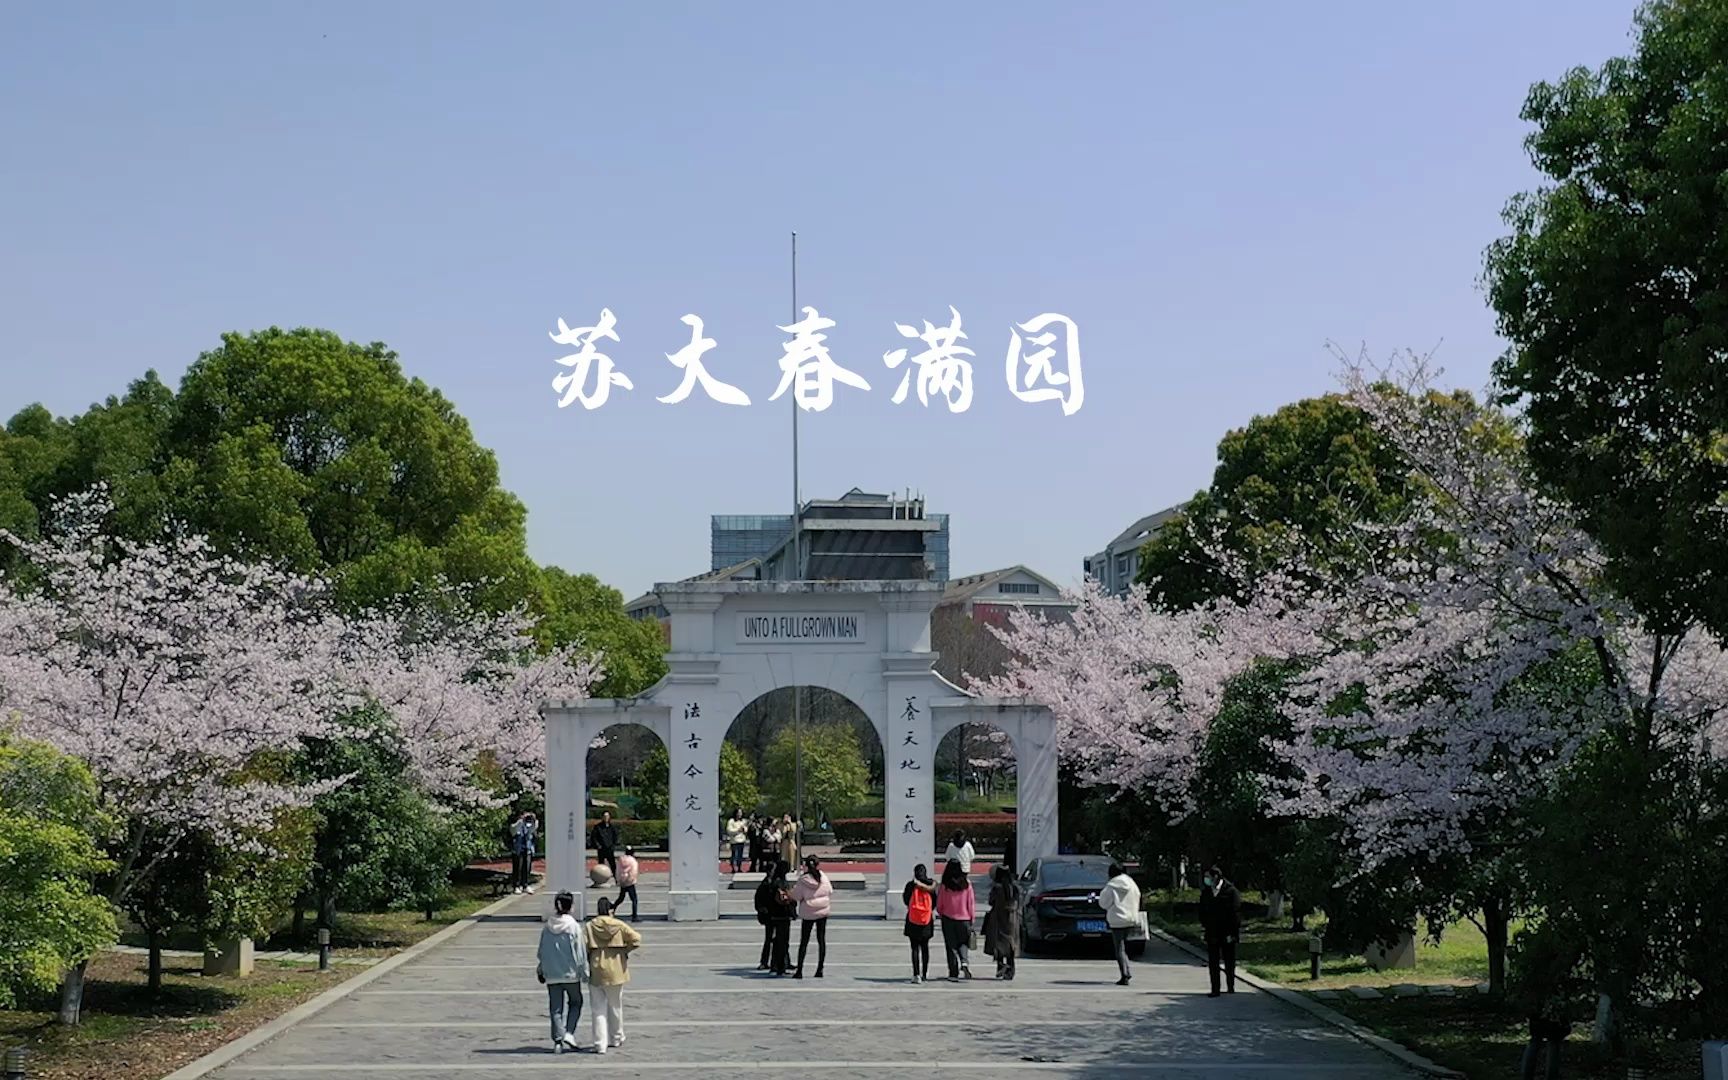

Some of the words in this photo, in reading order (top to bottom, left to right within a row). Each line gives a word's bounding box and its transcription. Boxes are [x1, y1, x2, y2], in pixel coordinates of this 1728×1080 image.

[744, 616, 769, 638] UNTO
[771, 617, 779, 638] A
[837, 616, 857, 638] MAN
[683, 702, 703, 839] 法古今完人
